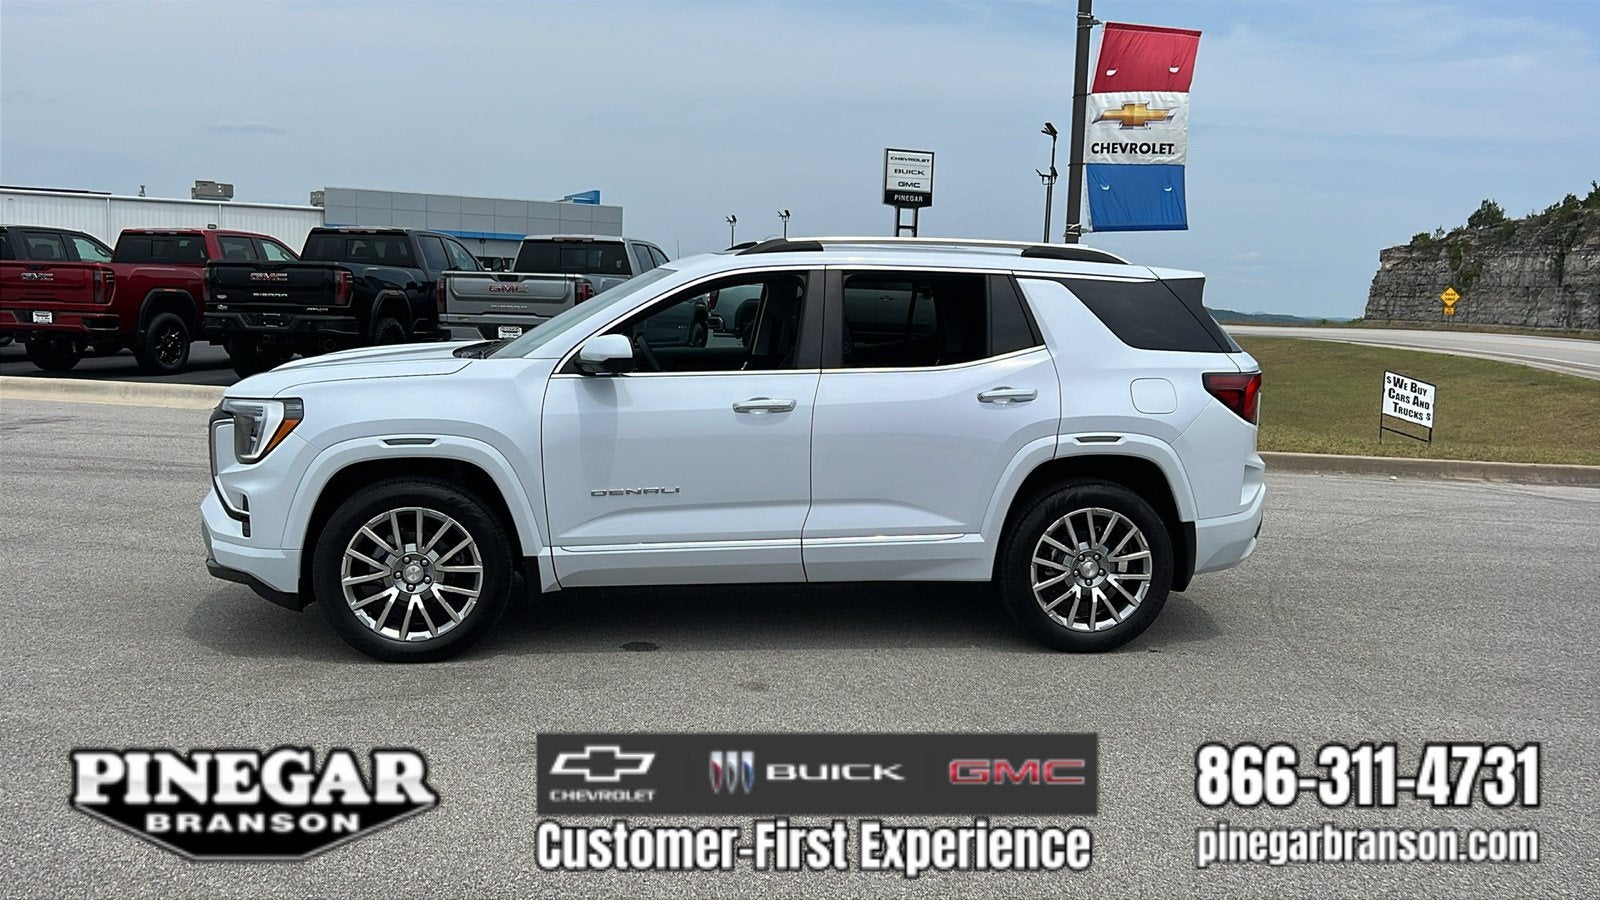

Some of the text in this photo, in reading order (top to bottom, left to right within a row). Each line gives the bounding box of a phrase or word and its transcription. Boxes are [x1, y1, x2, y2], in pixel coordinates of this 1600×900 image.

[894, 168, 925, 176] BUICK
[894, 194, 923, 202] PINEGAR
[489, 283, 528, 294] GMC
[590, 486, 680, 497] DENALI
